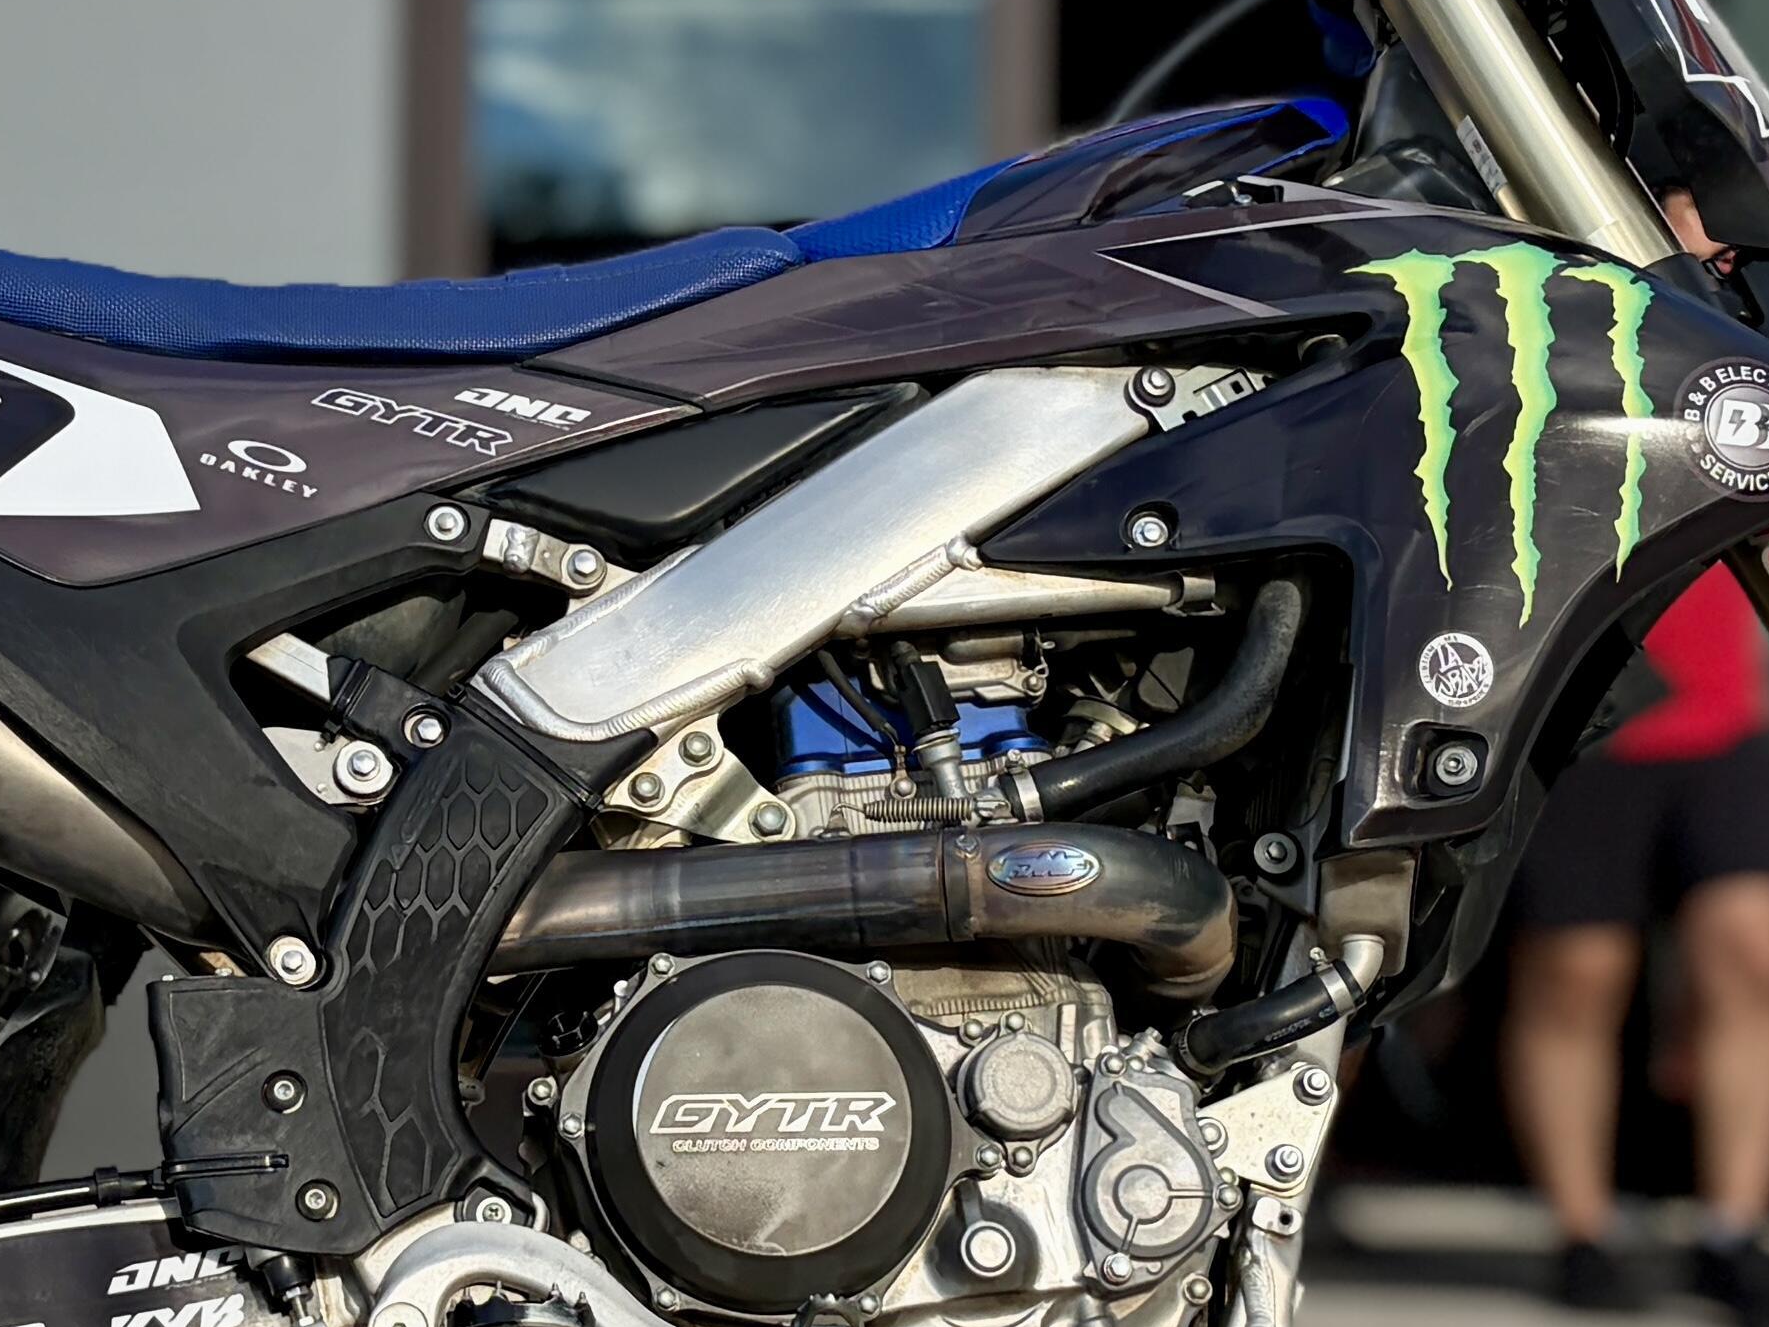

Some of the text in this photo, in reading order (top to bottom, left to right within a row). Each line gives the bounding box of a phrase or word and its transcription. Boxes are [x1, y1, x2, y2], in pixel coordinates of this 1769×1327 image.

[1699, 376, 1717, 393] B
[311, 387, 514, 457] GYTR
[199, 452, 319, 499] OAKLEY
[649, 1092, 897, 1134] GYTR
[672, 1136, 881, 1153] CLUTCH COMPONENTS
